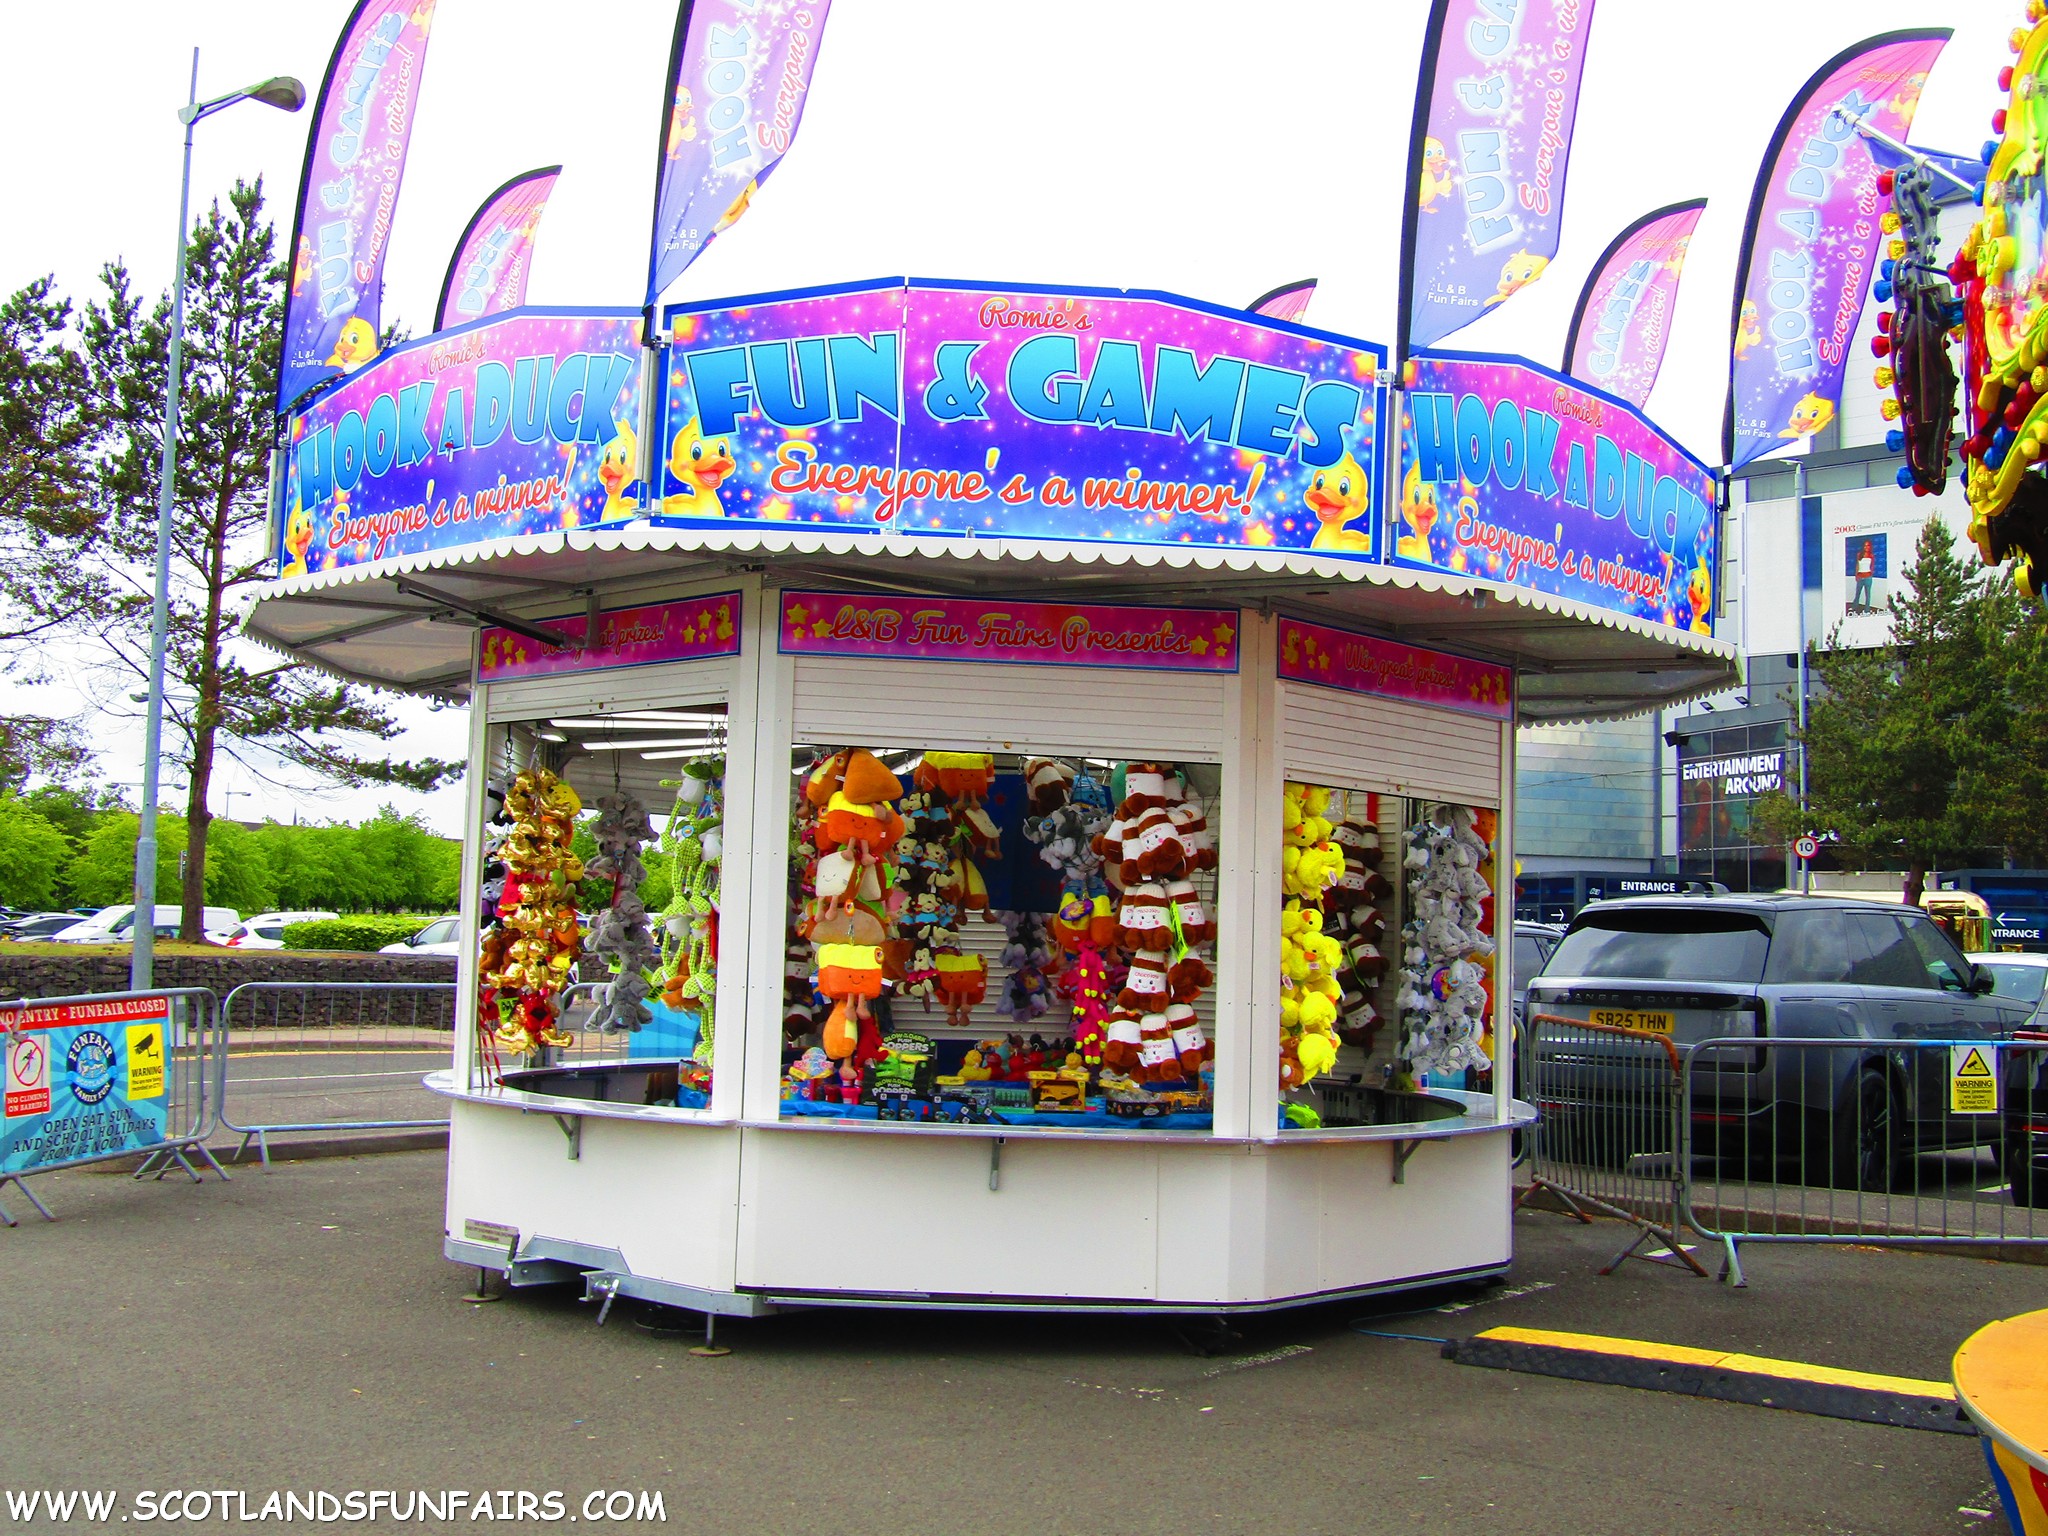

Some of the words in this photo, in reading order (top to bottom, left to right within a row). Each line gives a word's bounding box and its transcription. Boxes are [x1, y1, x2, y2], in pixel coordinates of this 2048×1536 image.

[1469, 0, 1519, 57] GA
[389, 42, 416, 135] winner!
[707, 25, 752, 168] HOOK
[756, 10, 813, 154] Everyone's
[1459, 75, 1506, 110] &
[1519, 67, 1567, 216] Everyone's
[1553, 40, 1572, 60] a
[1789, 90, 1872, 198] DUCK
[386, 142, 401, 159] a
[323, 178, 352, 208] &
[1460, 131, 1514, 247] FUN
[690, 228, 698, 239] B
[1779, 209, 1815, 240] A
[458, 224, 514, 312] DUCK
[1427, 292, 1448, 304] Fun
[1450, 295, 1479, 307] Fairs
[1437, 282, 1444, 293] L
[1446, 283, 1455, 294] &
[1457, 285, 1466, 295] B
[1817, 252, 1864, 366] Everyone's
[1855, 219, 1872, 239] a
[979, 296, 1094, 330] Romie's
[1589, 260, 1651, 375] GAMES
[1646, 284, 1668, 354] winner!
[1769, 250, 1815, 374] HOOK
[298, 350, 304, 359] L
[306, 358, 323, 367] airs
[428, 333, 487, 376] Romie's
[683, 329, 906, 440] FUN
[923, 341, 990, 424] &
[1005, 333, 1365, 469] GAMES
[1551, 386, 1603, 429] Romie's
[297, 380, 436, 513] HOOK
[437, 387, 465, 456] A
[470, 351, 639, 449] DUCK
[1734, 426, 1751, 436] Fun
[1741, 419, 1748, 427] L
[1750, 419, 1757, 427] &
[1760, 420, 1767, 429] B
[769, 440, 1032, 523] Everyone's
[1040, 475, 1076, 505] a
[1083, 461, 1267, 517] winner!
[1409, 391, 1561, 502] HOOK
[1564, 440, 1591, 511] A
[1592, 432, 1708, 571] DUCK
[326, 478, 450, 561] Everyone's
[452, 497, 470, 522] a
[473, 447, 578, 514] winner!
[1834, 525, 1856, 535] 2003
[1454, 495, 1576, 582] Everyone's
[1578, 559, 1595, 578] a
[1598, 555, 1675, 603] winner!
[616, 609, 670, 658] prizes!
[907, 609, 967, 646] Fun
[973, 612, 1055, 649] Fairs
[1060, 615, 1192, 654] Presents
[1344, 643, 1377, 674] Win
[1377, 654, 1415, 689] great
[1414, 663, 1459, 692] prizes!
[1682, 753, 1782, 781] ENTERTAINMENT
[1725, 774, 1781, 795] AROUND
[1798, 842, 1814, 852] 10
[1620, 881, 1676, 892] ENTRANCE
[1991, 928, 2040, 939] NTRANCE
[0, 1010, 15, 1026] NO
[69, 1002, 126, 1020] FUNFAIR
[126, 998, 167, 1014] CLOSED
[1563, 992, 1620, 1003] RANGE
[1632, 995, 1701, 1005] ROVER
[1595, 1012, 1633, 1028] SB25
[1638, 1014, 1667, 1030] THN
[69, 1032, 113, 1062] FUNFAIR
[131, 1065, 163, 1078] WARNING
[1955, 1080, 1993, 1088] WARNING
[75, 1086, 98, 1103] FAMILY
[97, 1082, 111, 1099] FUN
[12, 1138, 43, 1154] AND
[46, 1129, 95, 1149] SCHOOL
[98, 1118, 156, 1137] HOLIDAYS
[44, 1116, 80, 1134] OPEN
[109, 1107, 134, 1123] SUN
[40, 1145, 75, 1162] FROM
[77, 1144, 89, 1155] 12
[94, 1136, 128, 1151] NOON
